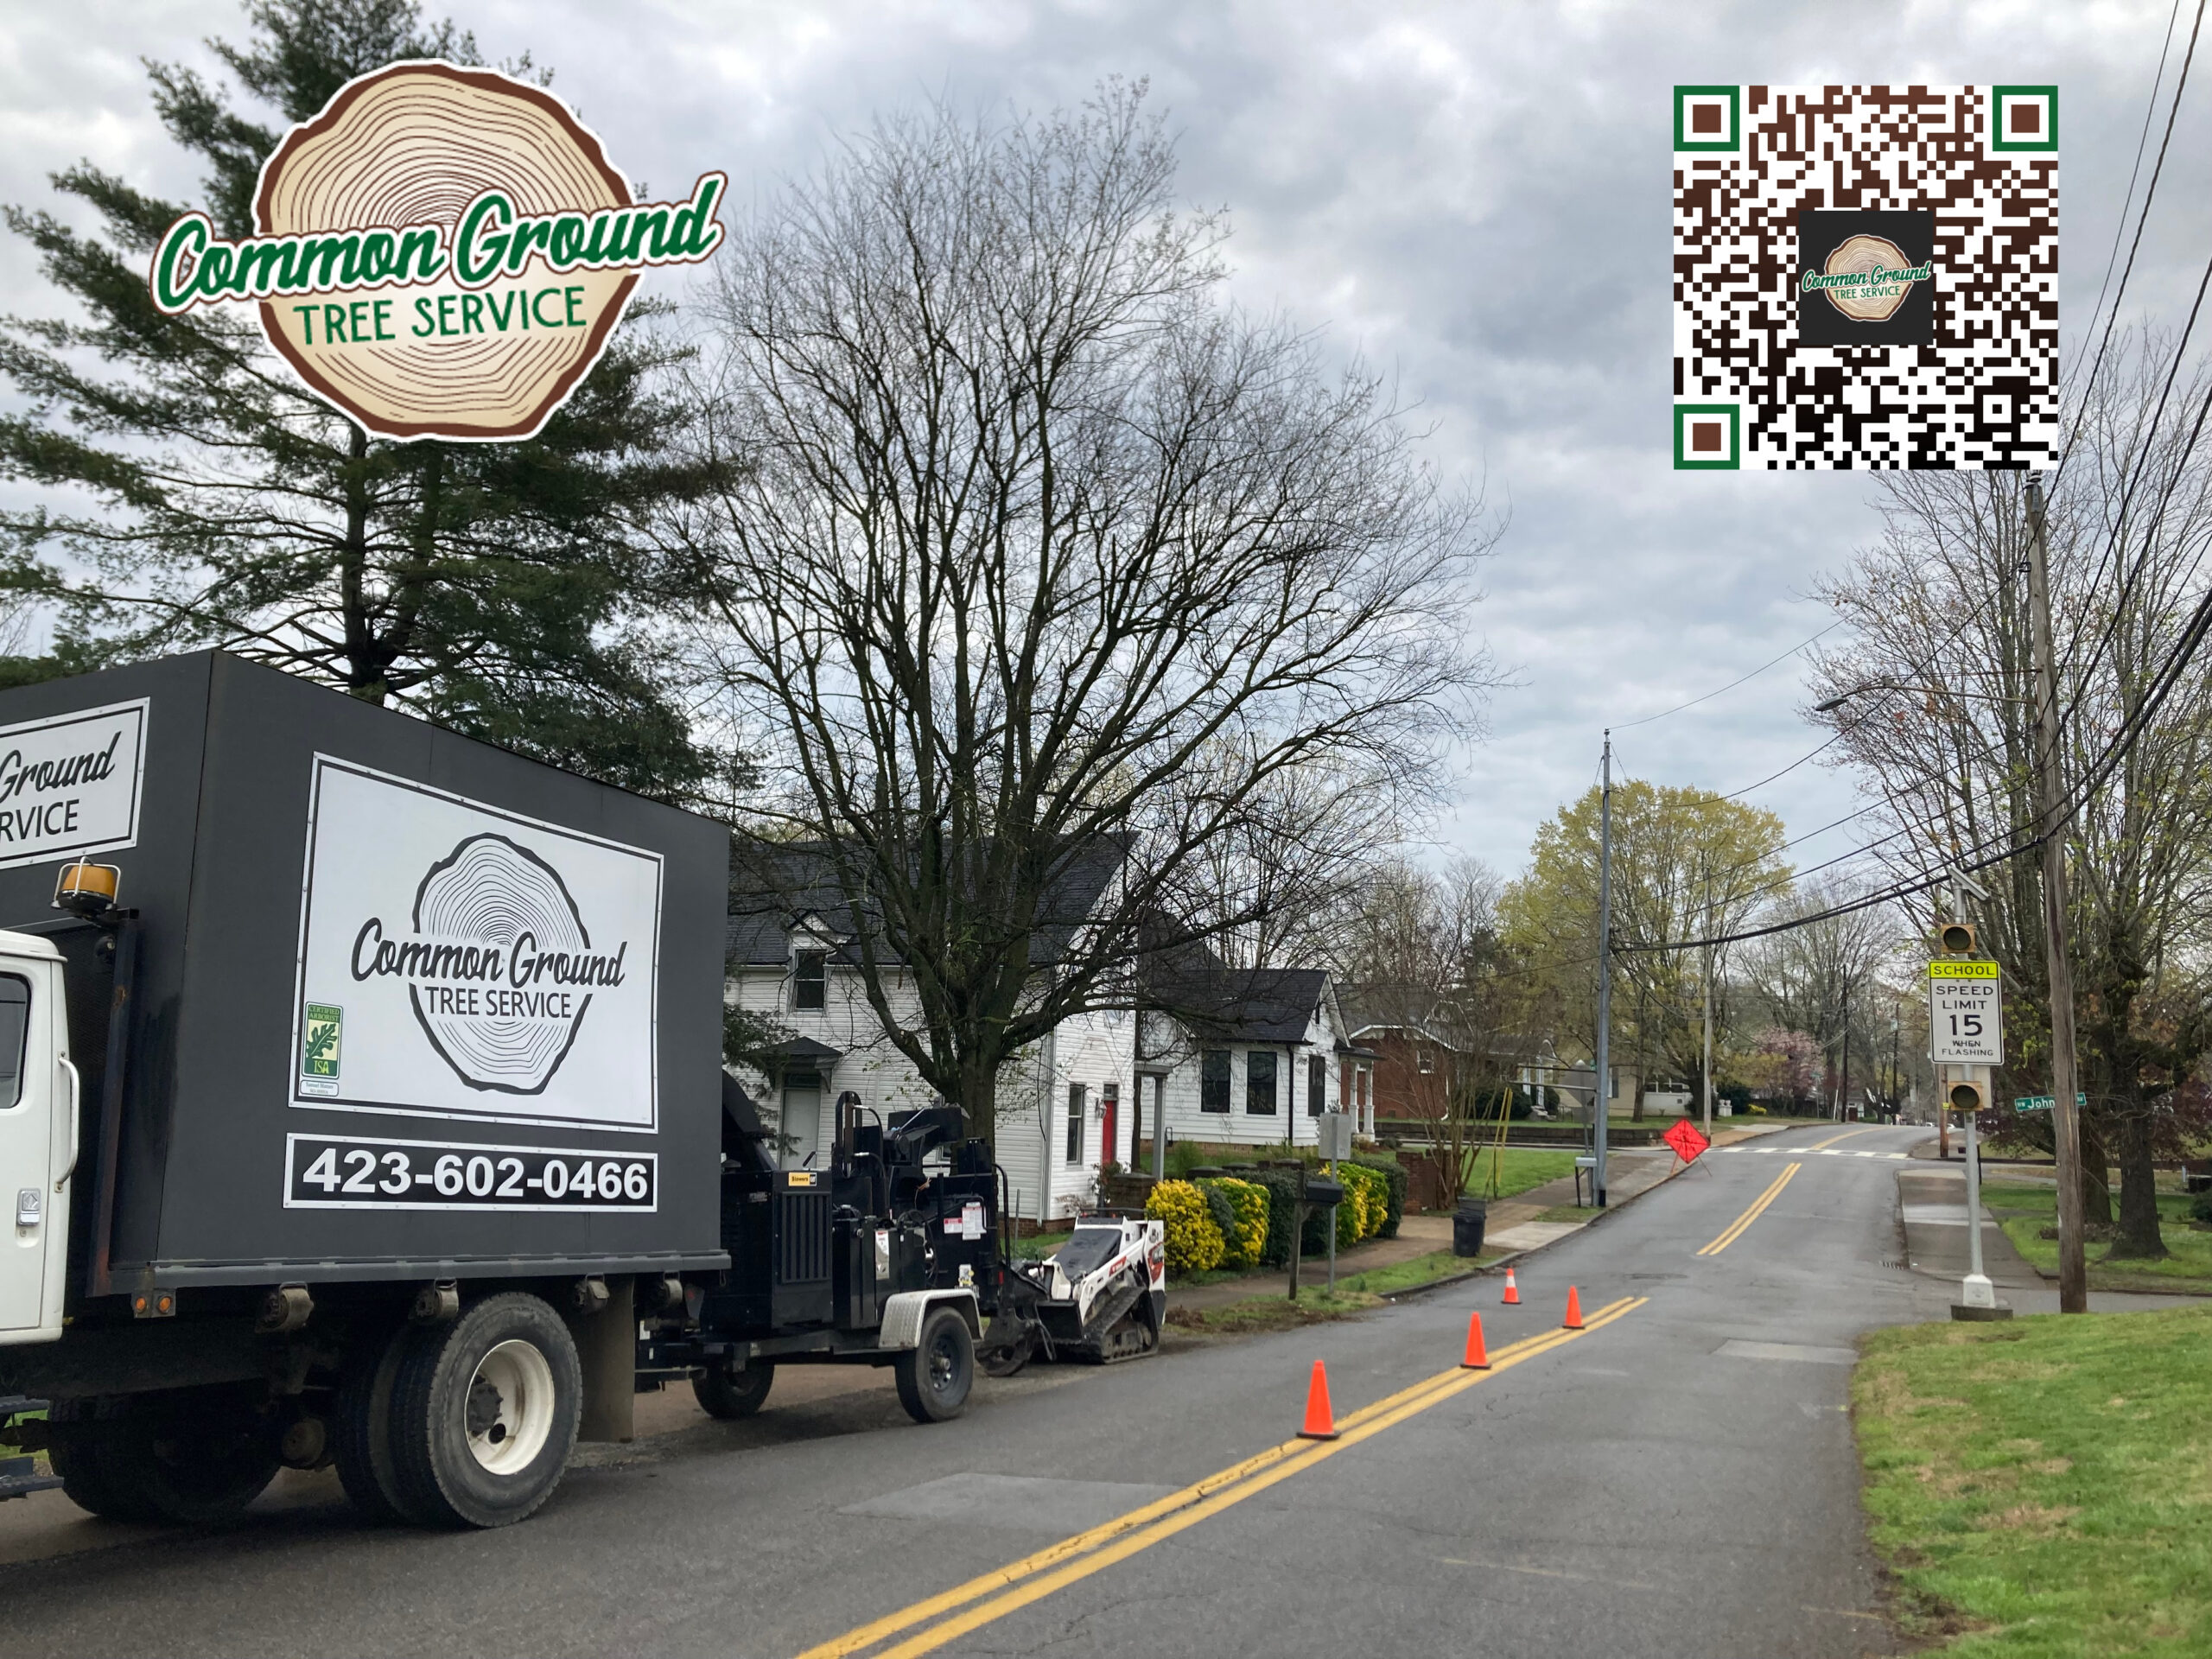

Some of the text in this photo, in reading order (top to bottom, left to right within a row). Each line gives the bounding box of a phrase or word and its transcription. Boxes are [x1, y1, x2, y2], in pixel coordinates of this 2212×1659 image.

[0, 730, 122, 804] Ground
[351, 917, 627, 988] Common Ground
[1934, 965, 1994, 976] SCHOOL
[1936, 985, 1993, 995] SPEED
[424, 986, 571, 1018] TREE SERVICE
[1942, 1000, 1986, 1010] LIMIT
[308, 1005, 340, 1015] CERTIFIED
[308, 1013, 340, 1022] ARBORIST
[1949, 1014, 1983, 1036] 15
[314, 1060, 330, 1074] ISA
[302, 1147, 648, 1199] 423-602-0466
